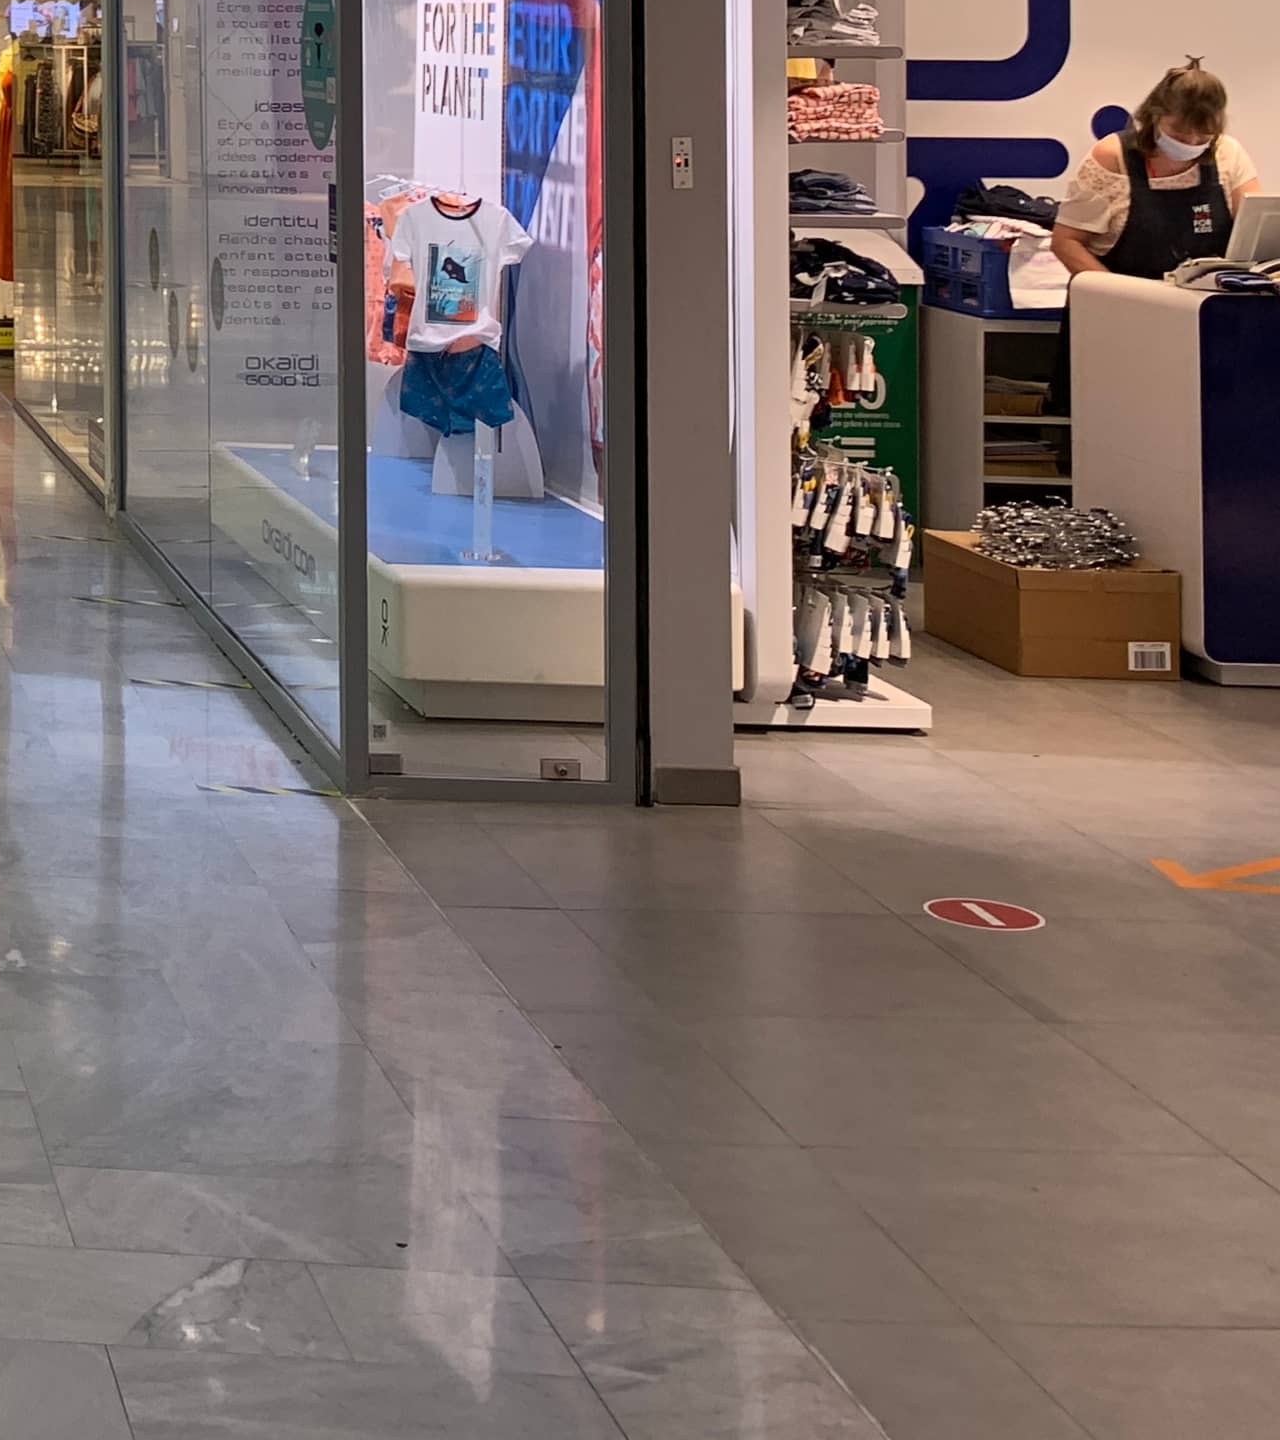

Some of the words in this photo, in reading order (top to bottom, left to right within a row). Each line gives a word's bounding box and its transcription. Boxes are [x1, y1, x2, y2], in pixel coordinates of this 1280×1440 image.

[258, 2, 304, 13] acces
[423, 3, 456, 54] FOR
[462, 3, 496, 56] THE
[241, 34, 302, 45] meilleu
[241, 51, 299, 63] marqu
[422, 64, 489, 121] PLANET
[255, 99, 304, 112] ideas
[265, 153, 334, 163] moderne
[244, 215, 319, 229] identity
[284, 233, 331, 247] chaqu
[284, 252, 330, 262] acteu
[244, 268, 334, 279] responsabl
